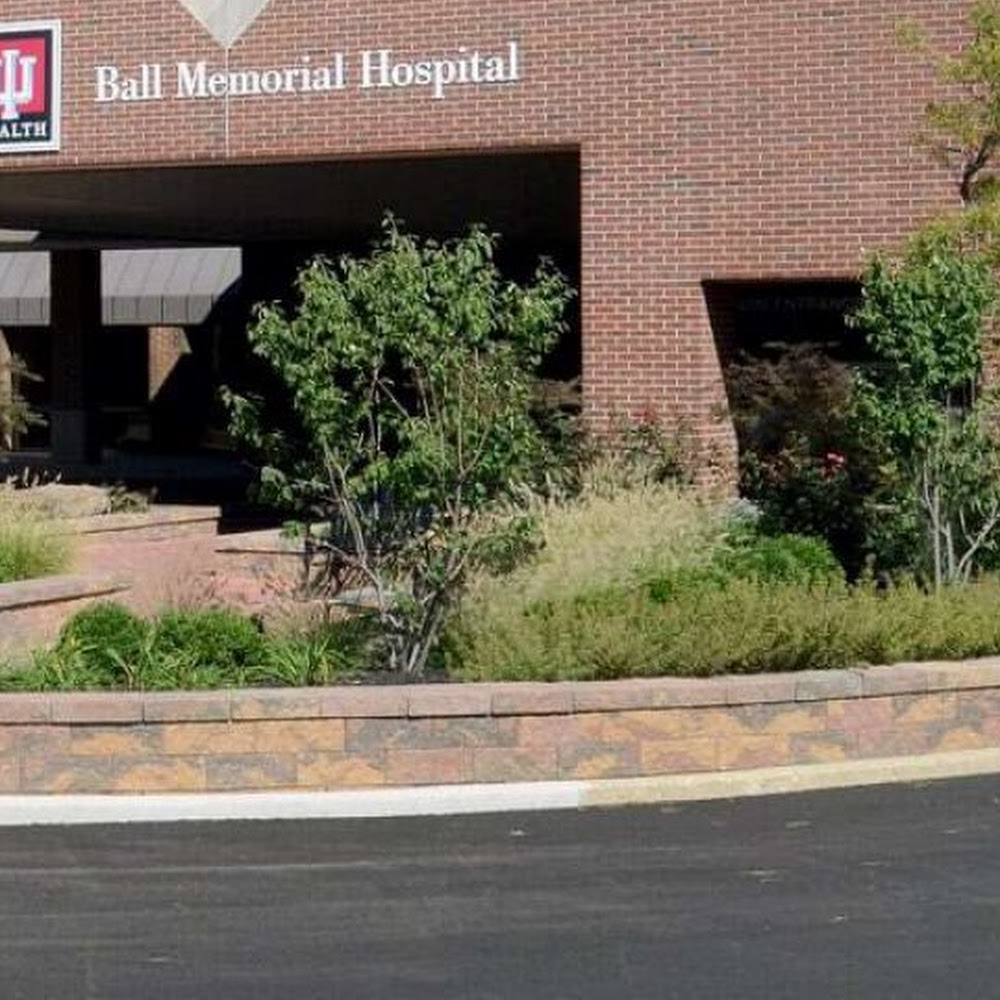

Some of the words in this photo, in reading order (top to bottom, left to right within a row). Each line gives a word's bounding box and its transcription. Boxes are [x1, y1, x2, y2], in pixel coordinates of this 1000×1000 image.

[94, 63, 162, 102] Ball
[175, 52, 346, 99] Memorial
[359, 41, 520, 99] Hospital
